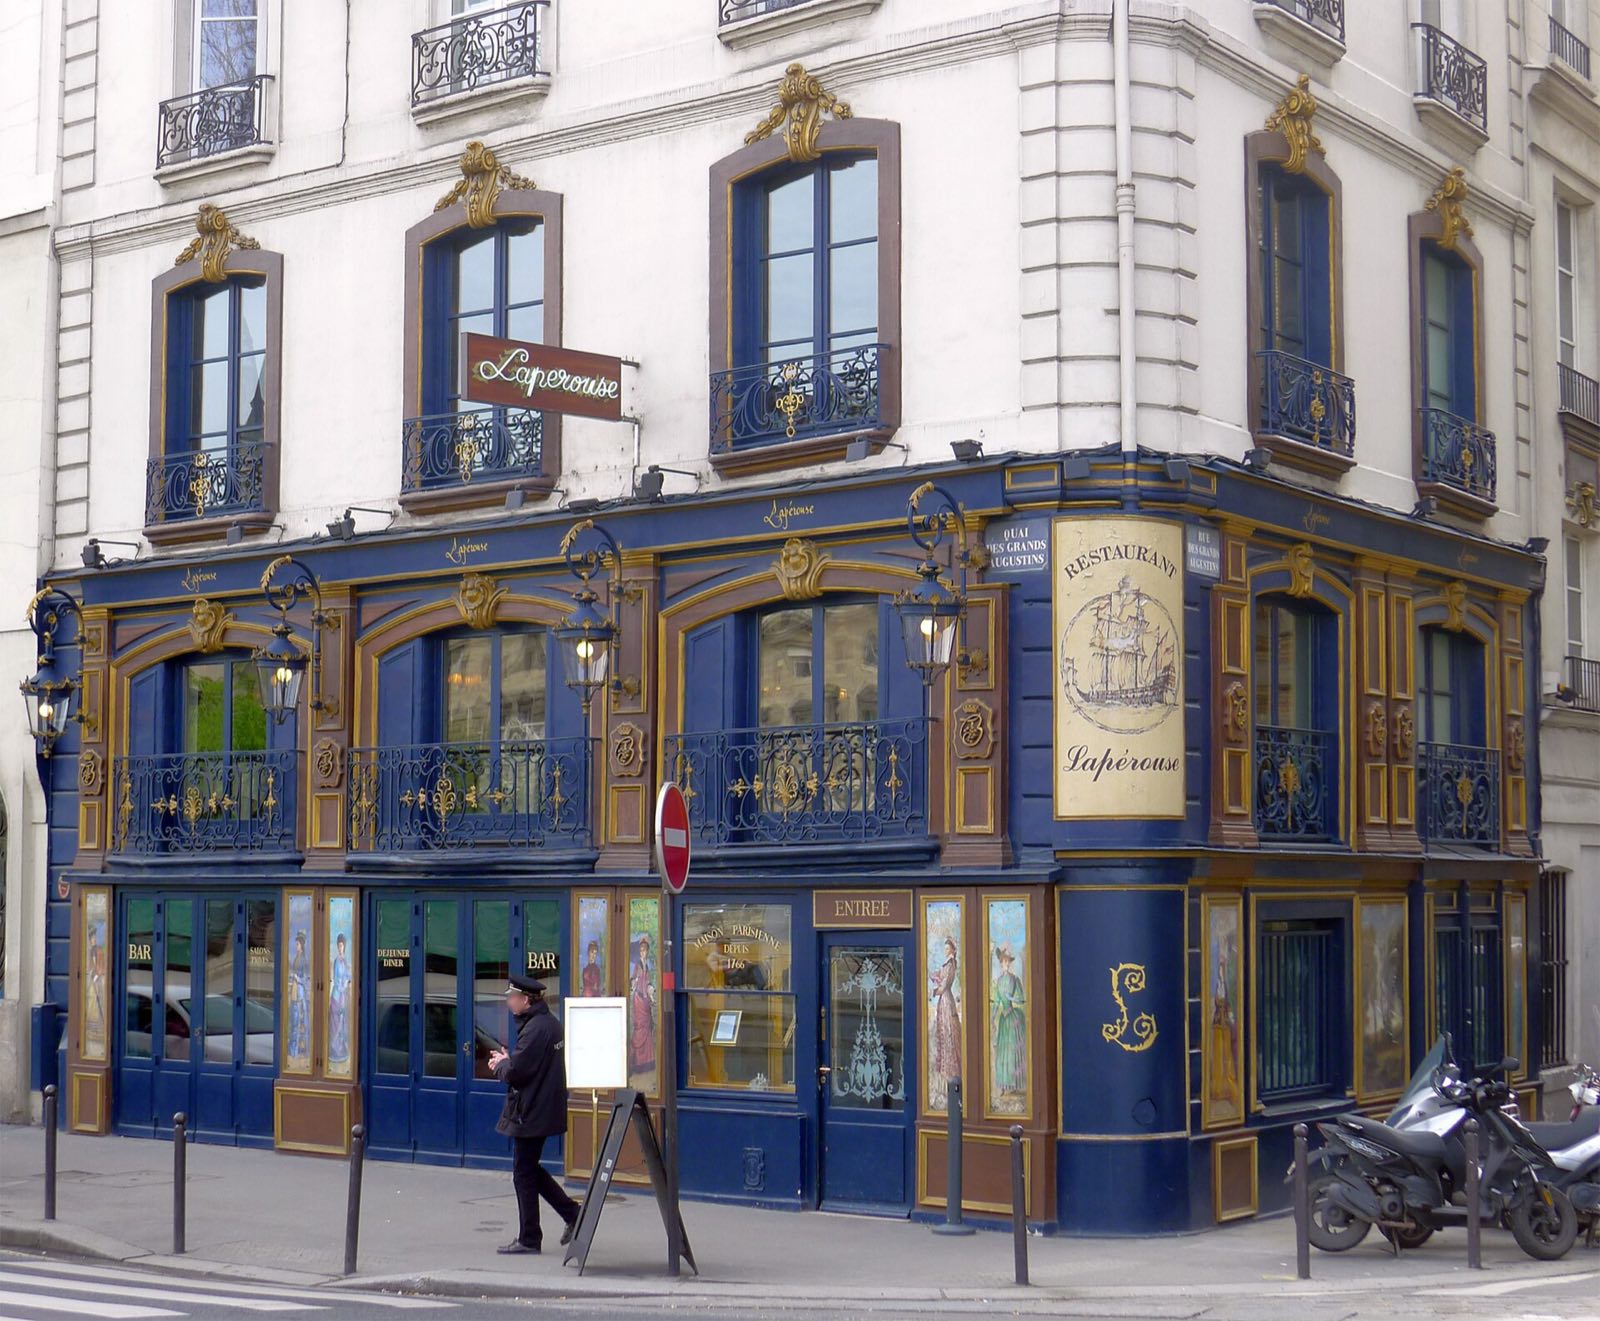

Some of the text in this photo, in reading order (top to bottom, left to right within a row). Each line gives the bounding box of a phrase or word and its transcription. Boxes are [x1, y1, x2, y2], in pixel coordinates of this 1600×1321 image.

[763, 499, 814, 529] Lapérouse
[1003, 527, 1028, 541] QUAI
[1198, 531, 1210, 543] RUE
[1006, 539, 1047, 553] GRANDS
[1063, 544, 1178, 580] RESTAURANT
[1062, 744, 1180, 782] Lapérouse
[834, 900, 891, 917] ENTREE
[693, 924, 782, 951] MAISON PARISIENNE
[128, 944, 152, 960] BAR
[377, 949, 410, 958] DEJEUNER
[723, 944, 750, 954] DEPUIS
[383, 958, 404, 967] DINER
[527, 951, 557, 969] BAR
[727, 958, 746, 969] 1766
